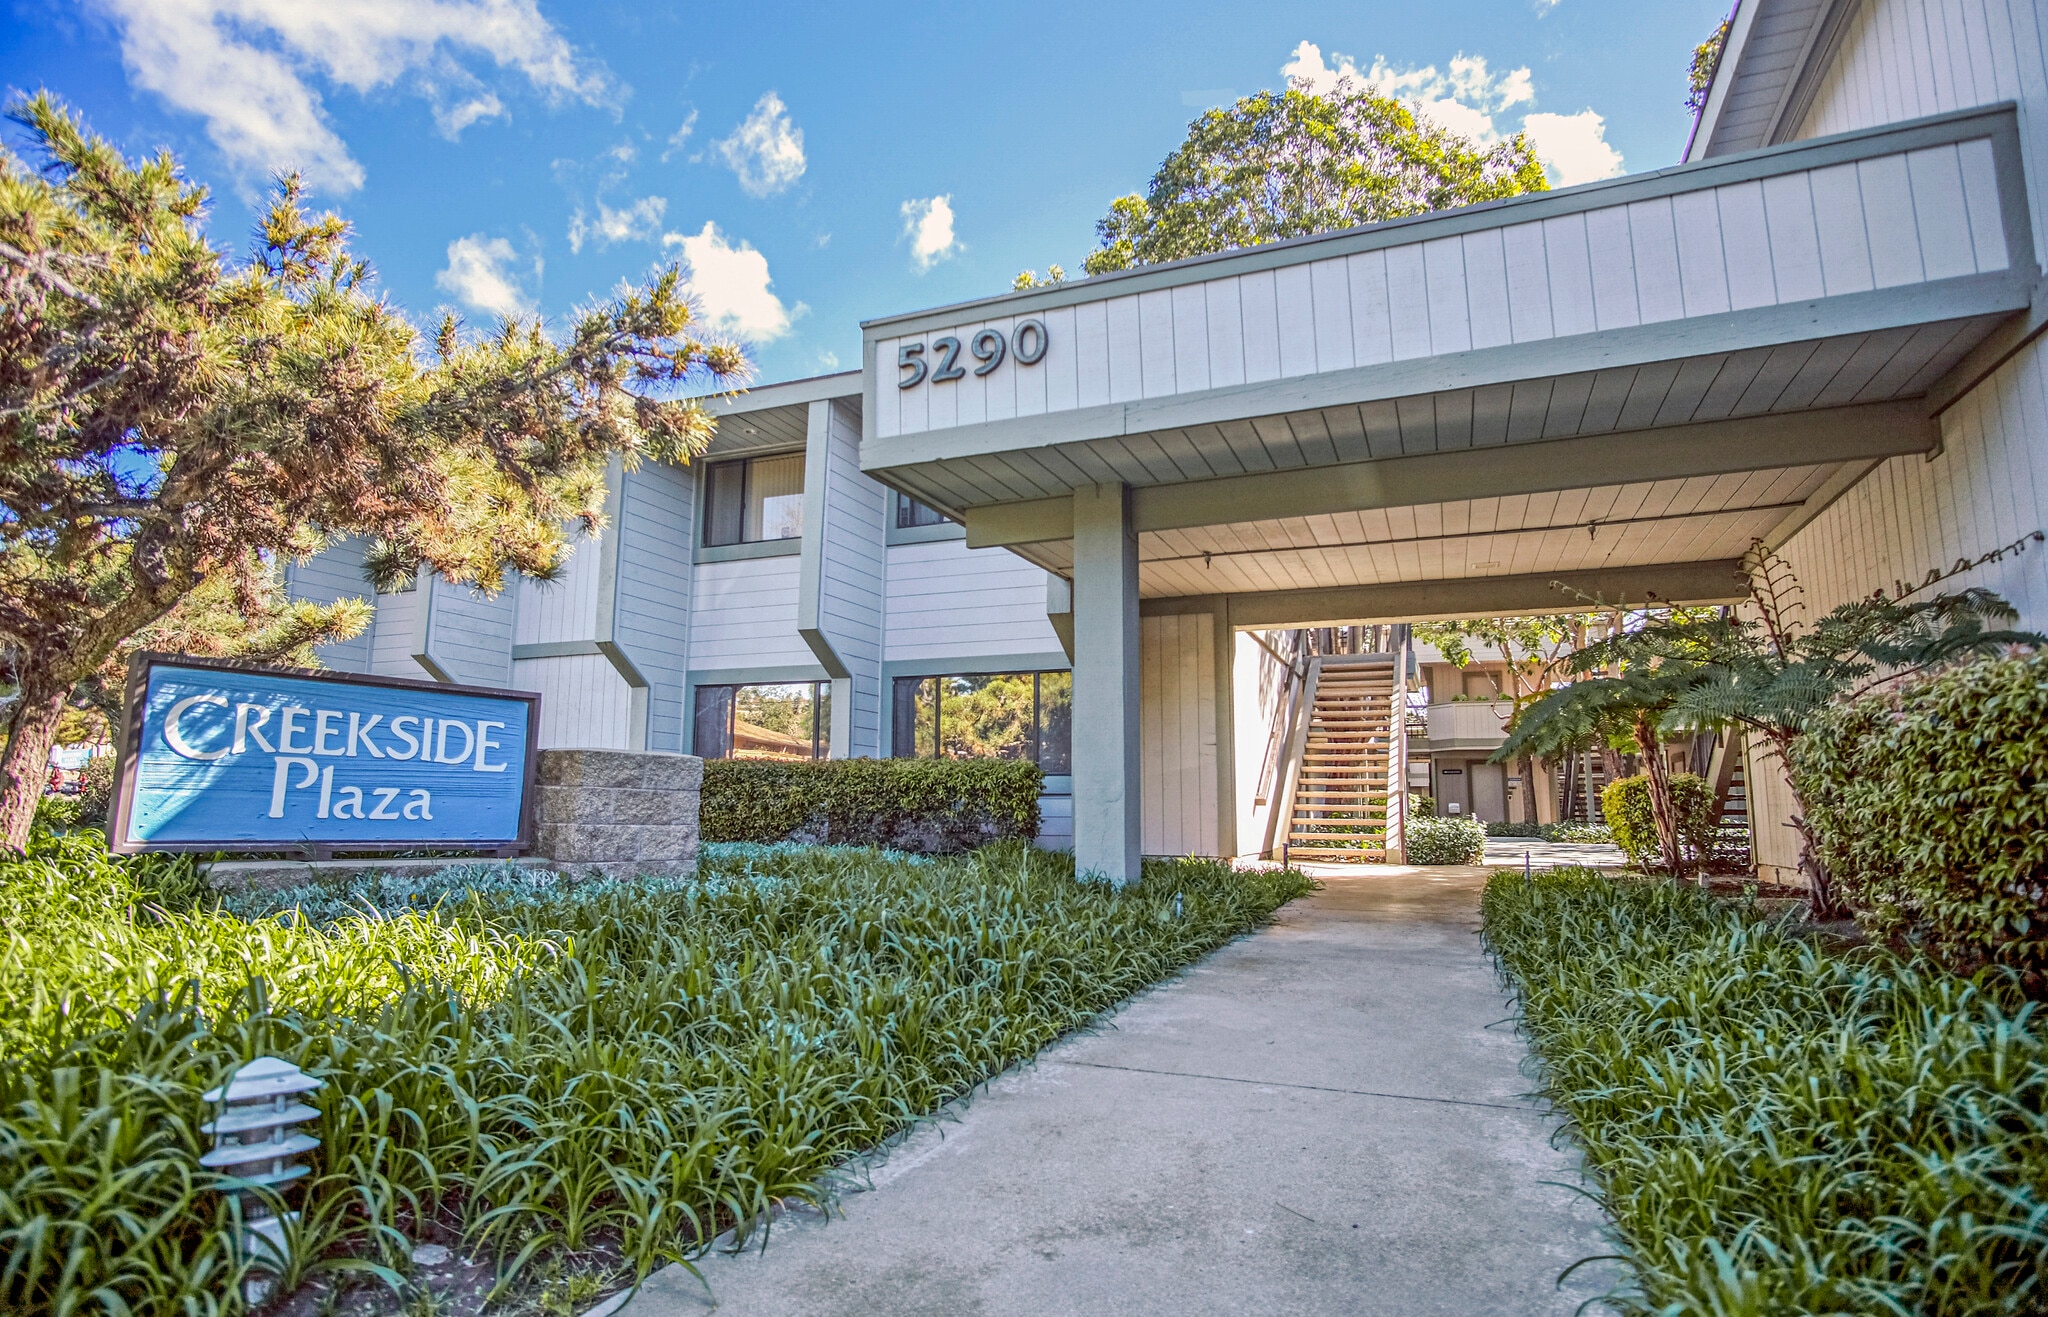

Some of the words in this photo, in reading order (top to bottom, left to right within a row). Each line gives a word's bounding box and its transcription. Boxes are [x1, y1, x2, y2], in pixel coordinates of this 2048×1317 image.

[898, 319, 1049, 390] 5290
[164, 694, 507, 772] CREEKSIDE
[268, 756, 434, 821] Plaza
